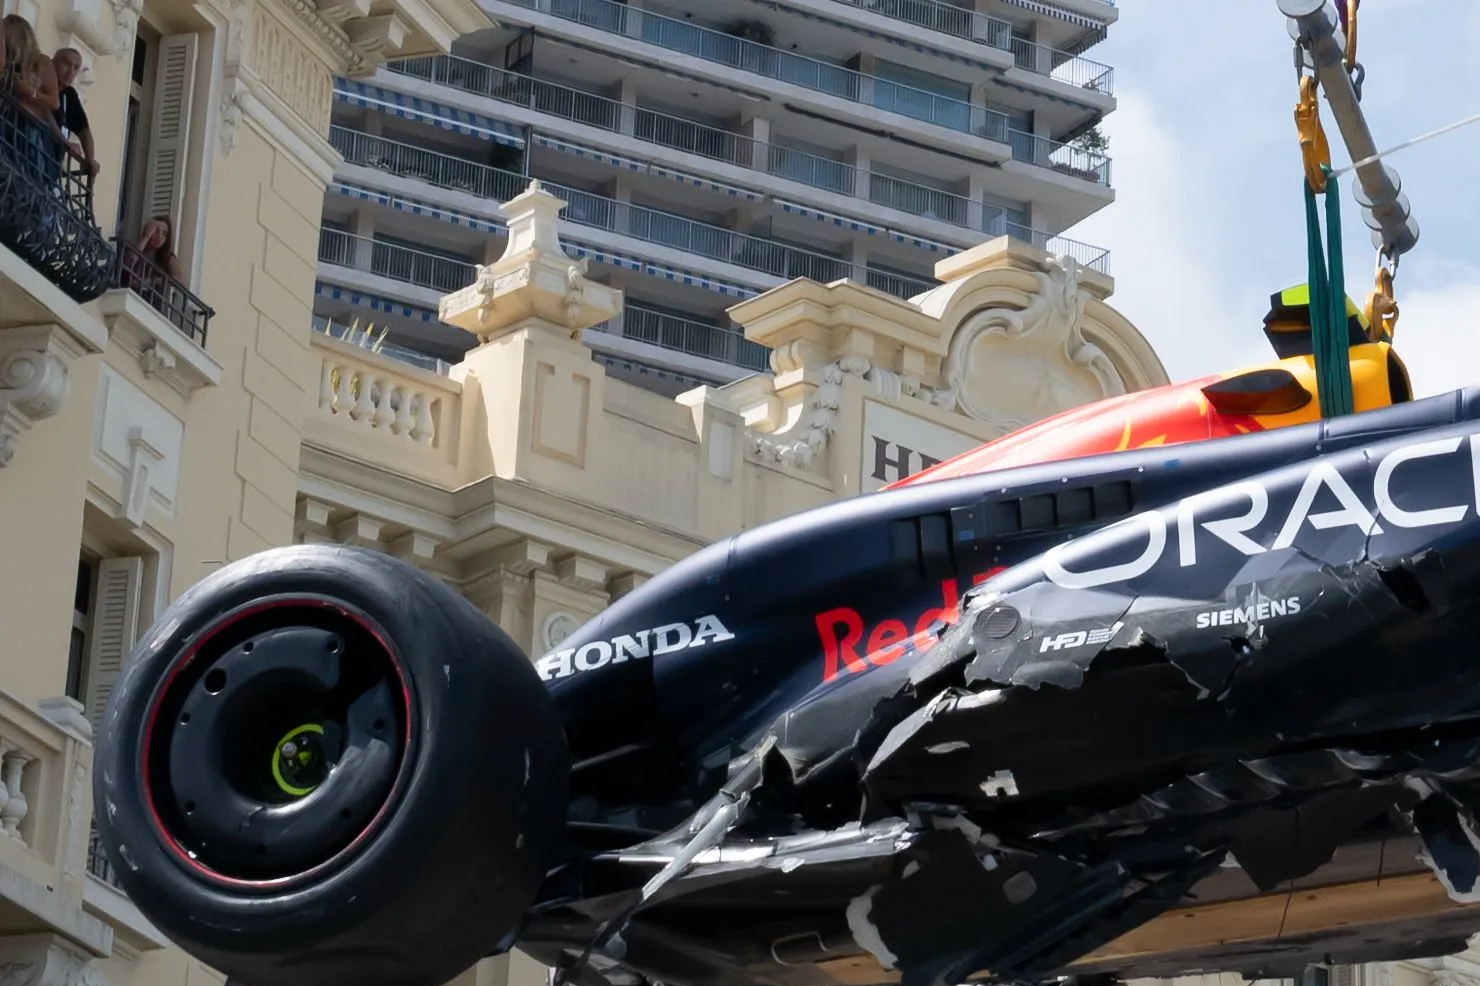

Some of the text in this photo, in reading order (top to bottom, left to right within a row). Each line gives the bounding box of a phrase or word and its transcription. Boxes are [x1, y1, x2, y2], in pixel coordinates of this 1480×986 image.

[815, 578, 960, 684] Red
[1196, 596, 1301, 629] SIEMENS
[535, 614, 735, 682] HONDA
